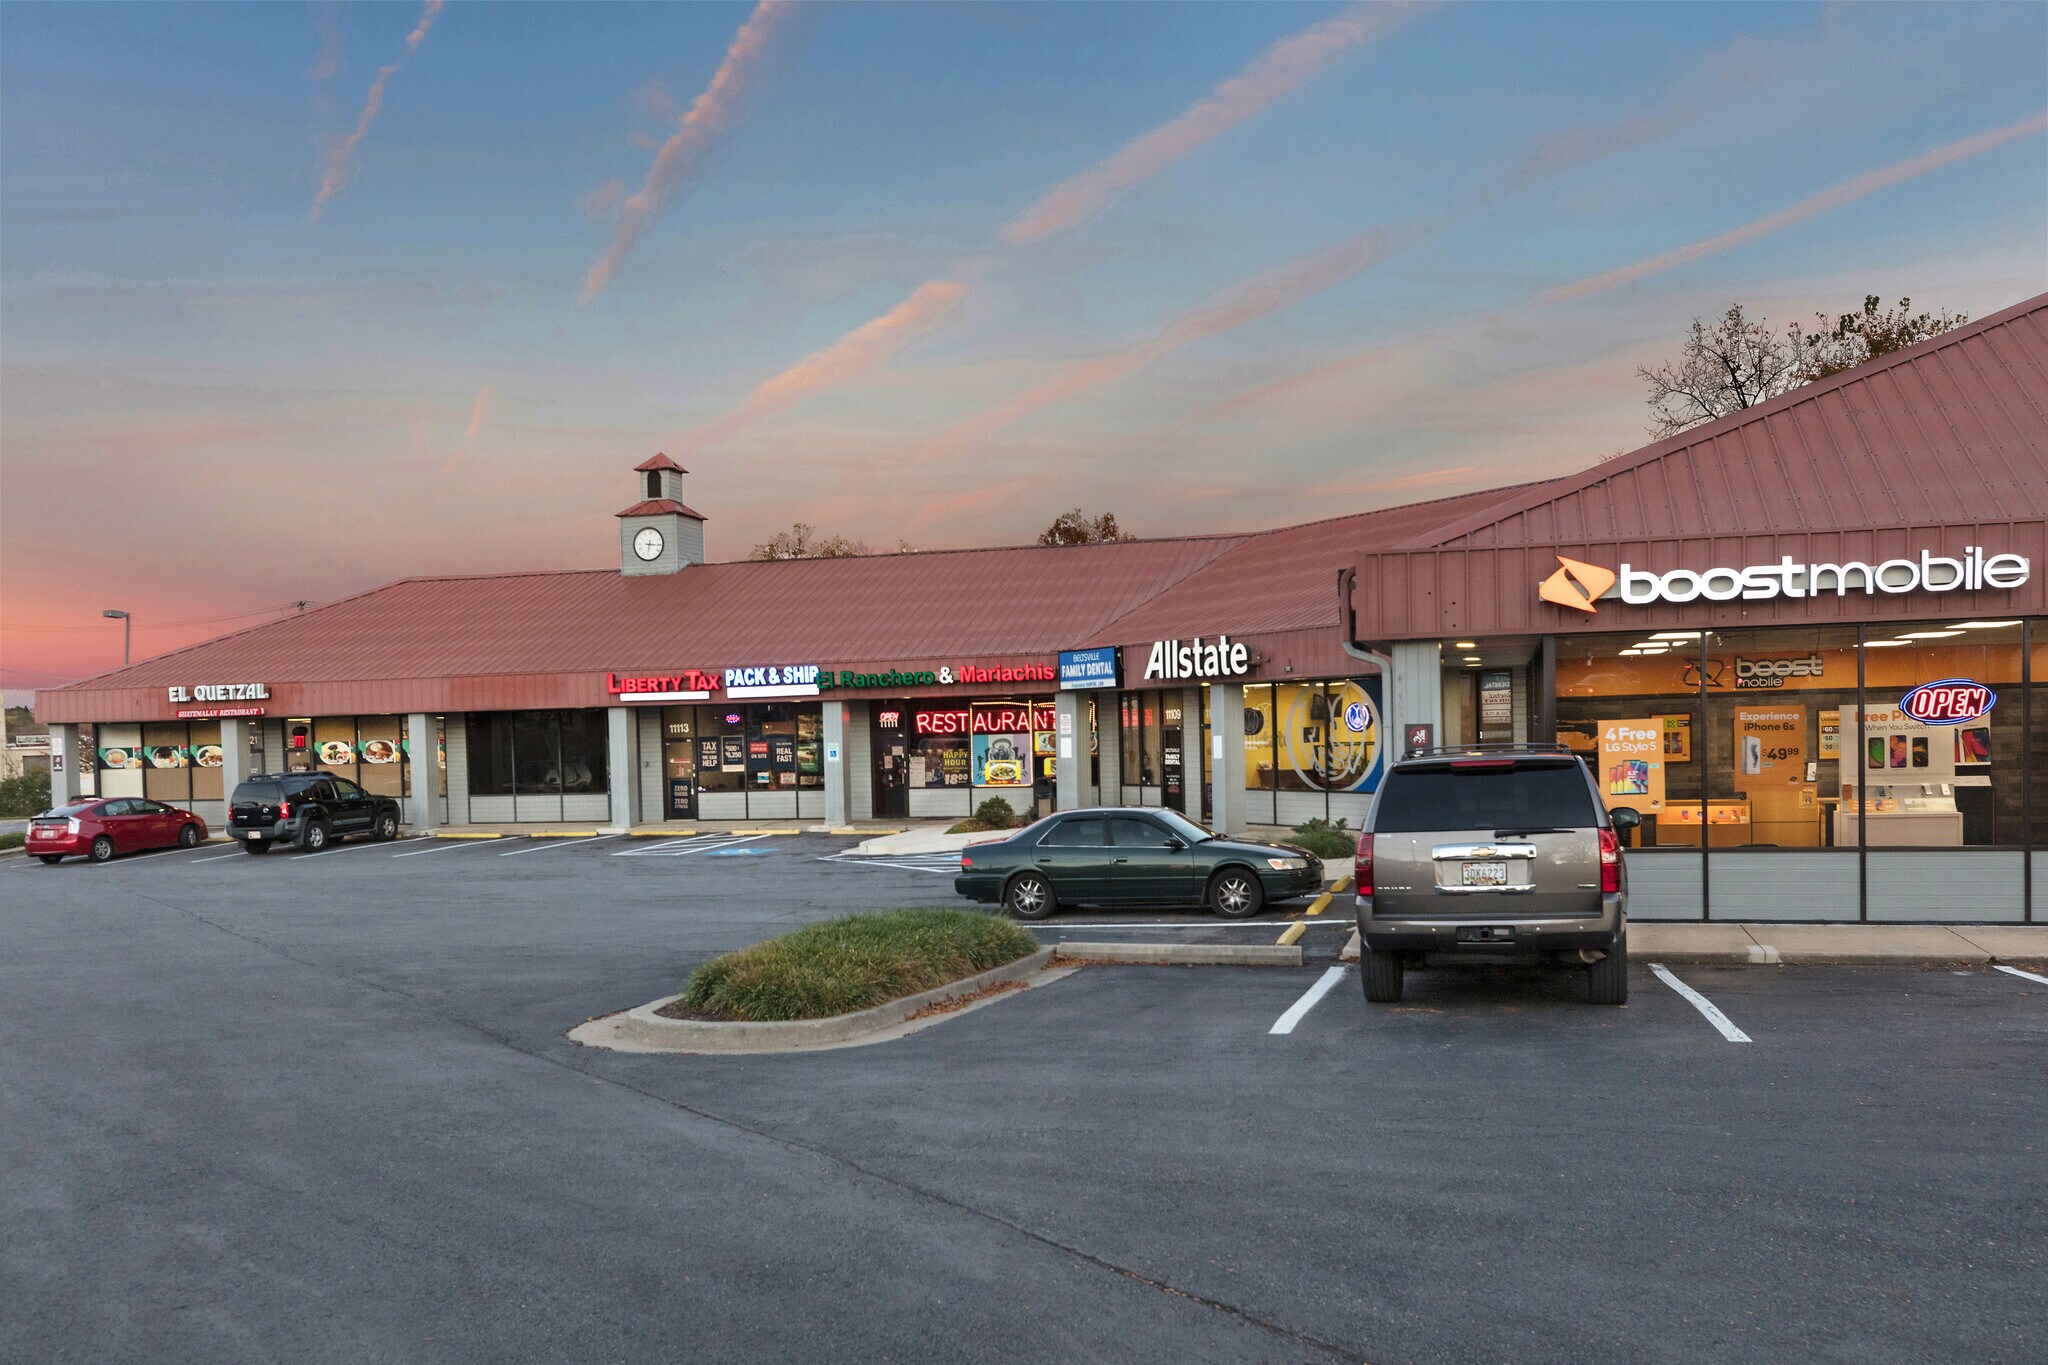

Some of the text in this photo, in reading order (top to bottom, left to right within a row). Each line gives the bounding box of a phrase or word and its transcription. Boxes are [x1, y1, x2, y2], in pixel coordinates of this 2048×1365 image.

[1073, 652, 1100, 662] BELTSVILLE
[1144, 635, 1248, 679] Allstate
[1061, 661, 1113, 678] FAMILY DENTAL
[1736, 655, 1823, 677] boost
[725, 665, 820, 686] PACK & SHIP
[816, 663, 1055, 689] El Ranchero & Mariachis
[607, 673, 682, 693] LIBERTY
[1737, 677, 1783, 688] mobile
[168, 683, 269, 702] EL QUETZAL
[1911, 688, 1986, 718] OPEN
[178, 708, 259, 718] GUATEMALAN RESTAURANT
[1165, 709, 1181, 719] 11109
[1740, 712, 1799, 723] Experience
[669, 724, 689, 733] 11113
[1744, 722, 1795, 731] iPhone 6s
[1605, 727, 1657, 740] 4 Free
[702, 741, 717, 750] TAX
[1606, 742, 1620, 752] LG
[1648, 742, 1657, 751] 5
[776, 747, 793, 755] REAL
[943, 751, 968, 759] HAPPY
[776, 755, 793, 763] FAST
[944, 758, 966, 766] HOUR
